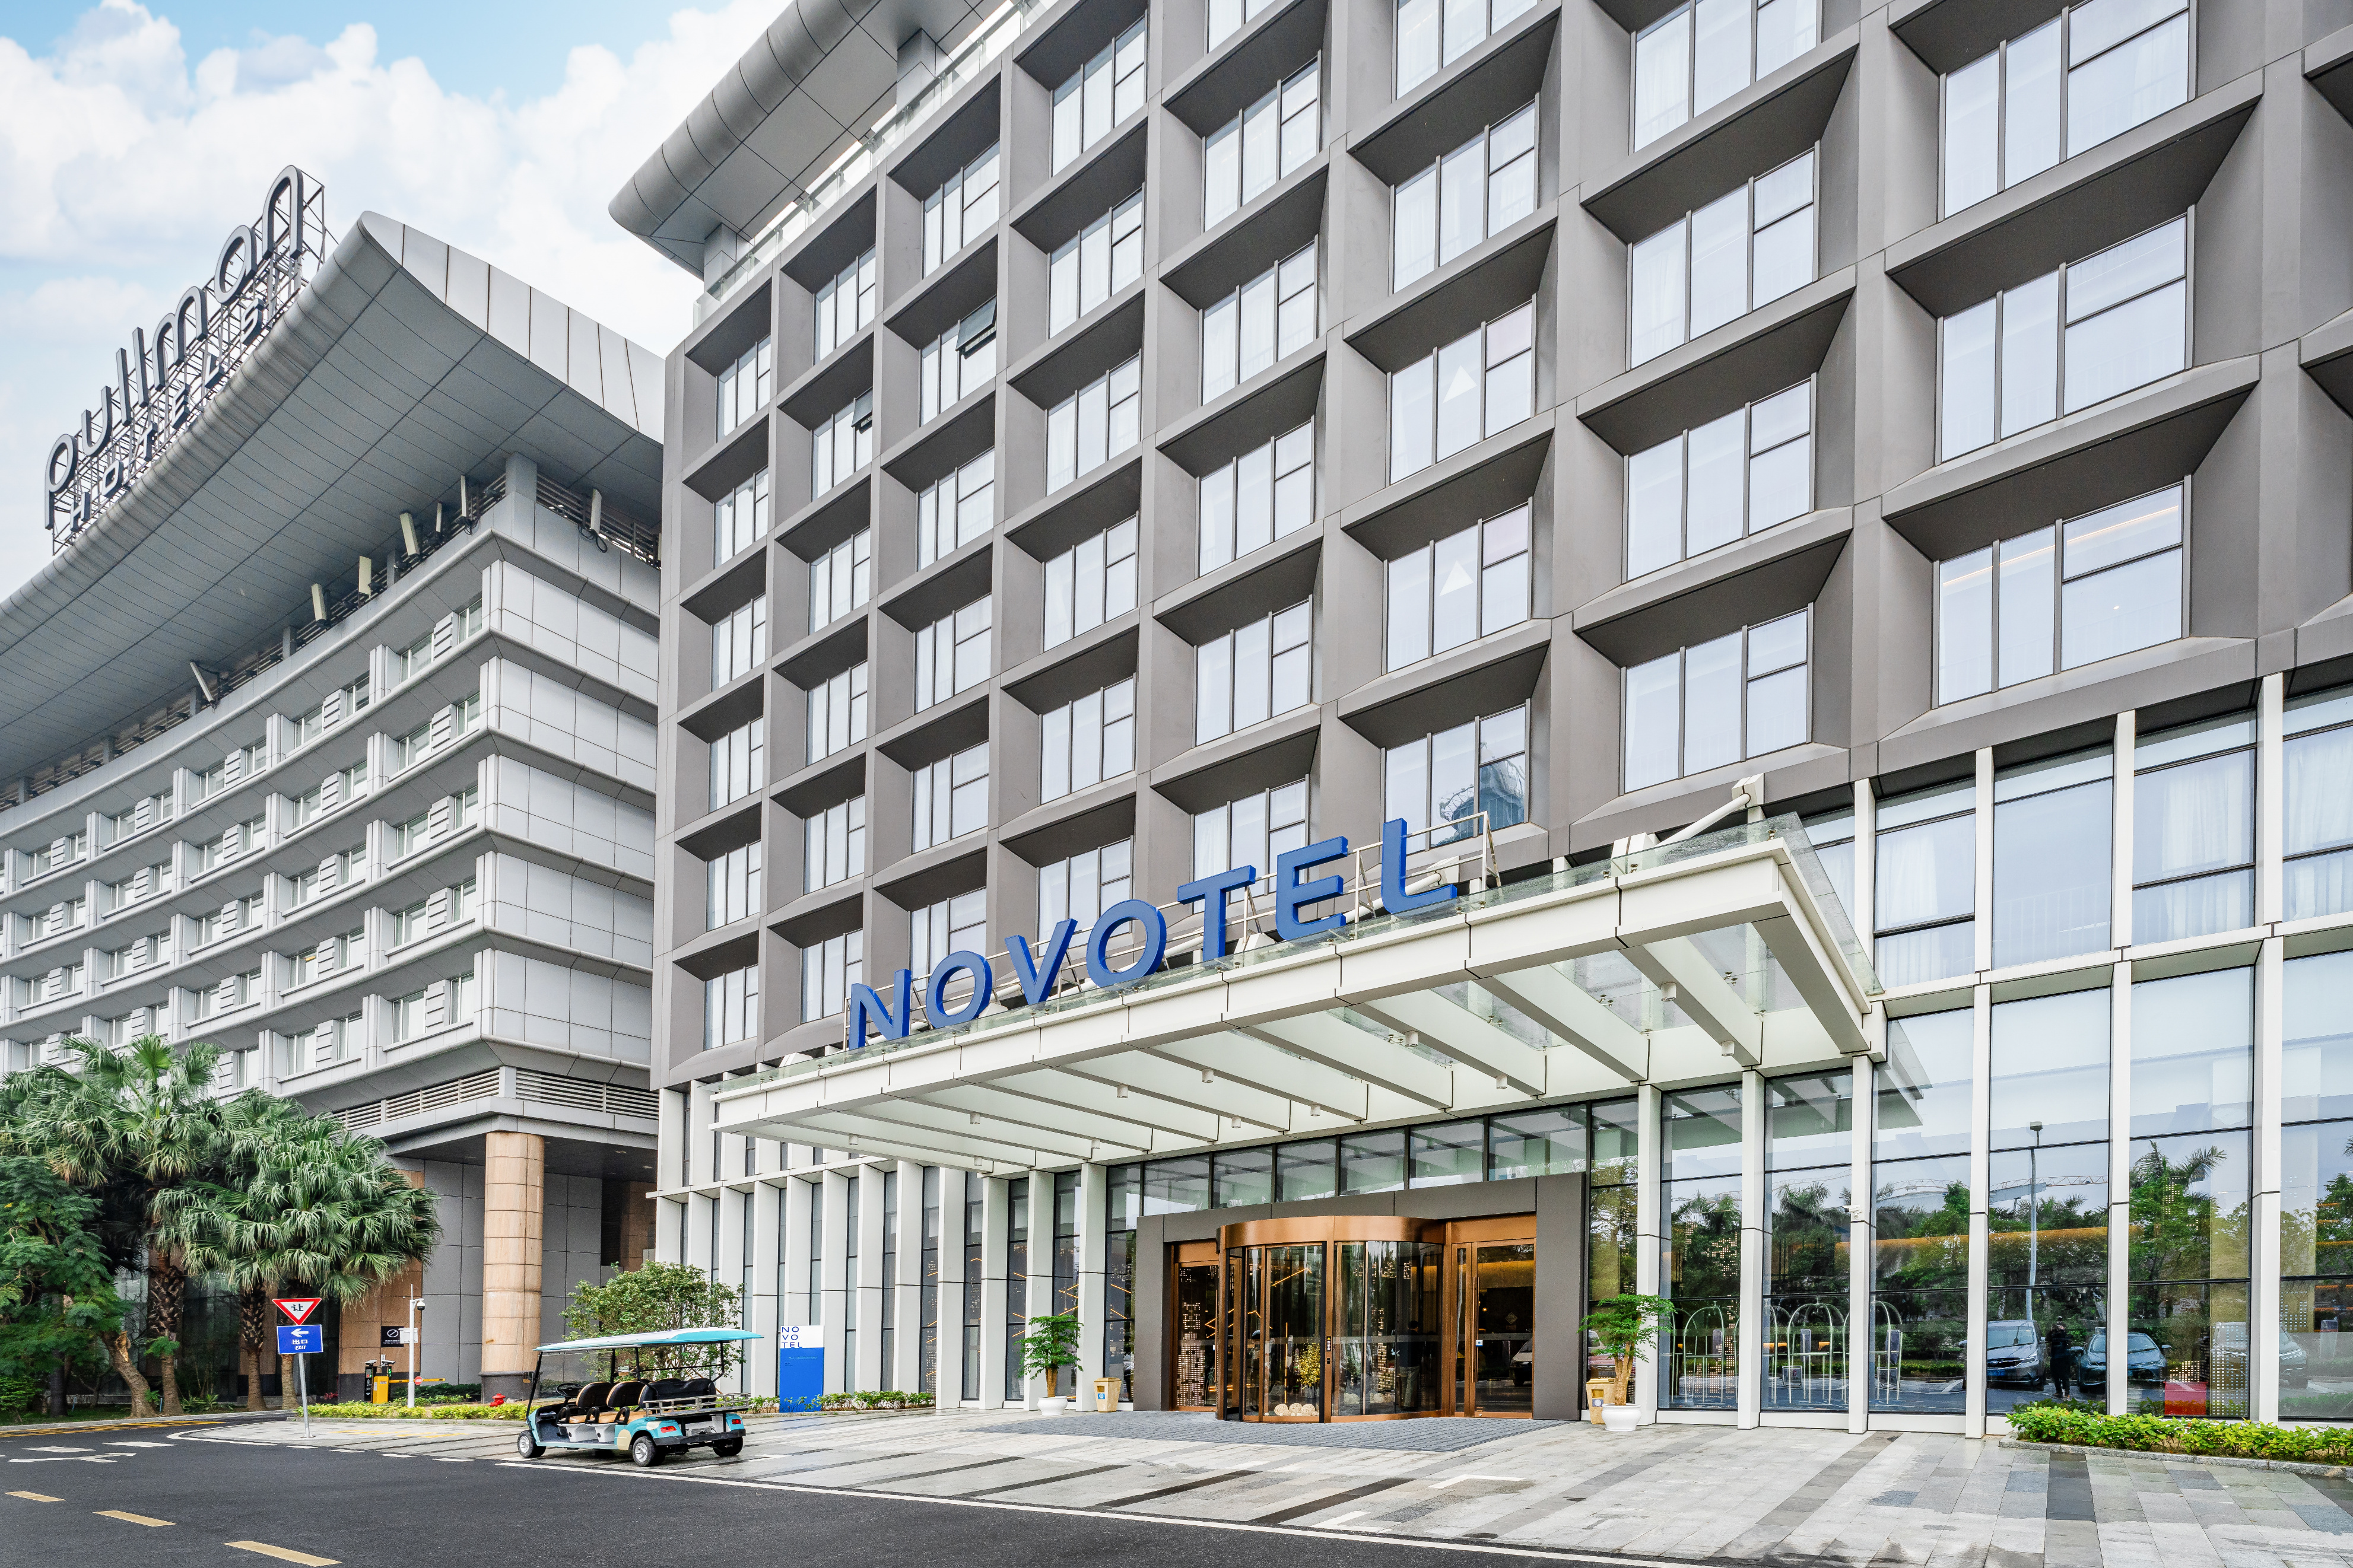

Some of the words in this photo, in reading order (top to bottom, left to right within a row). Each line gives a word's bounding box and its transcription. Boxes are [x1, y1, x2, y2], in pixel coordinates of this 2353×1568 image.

[45, 165, 303, 530] pullman
[70, 298, 264, 532] HOTELS
[849, 818, 1457, 1049] NOVOTEL
